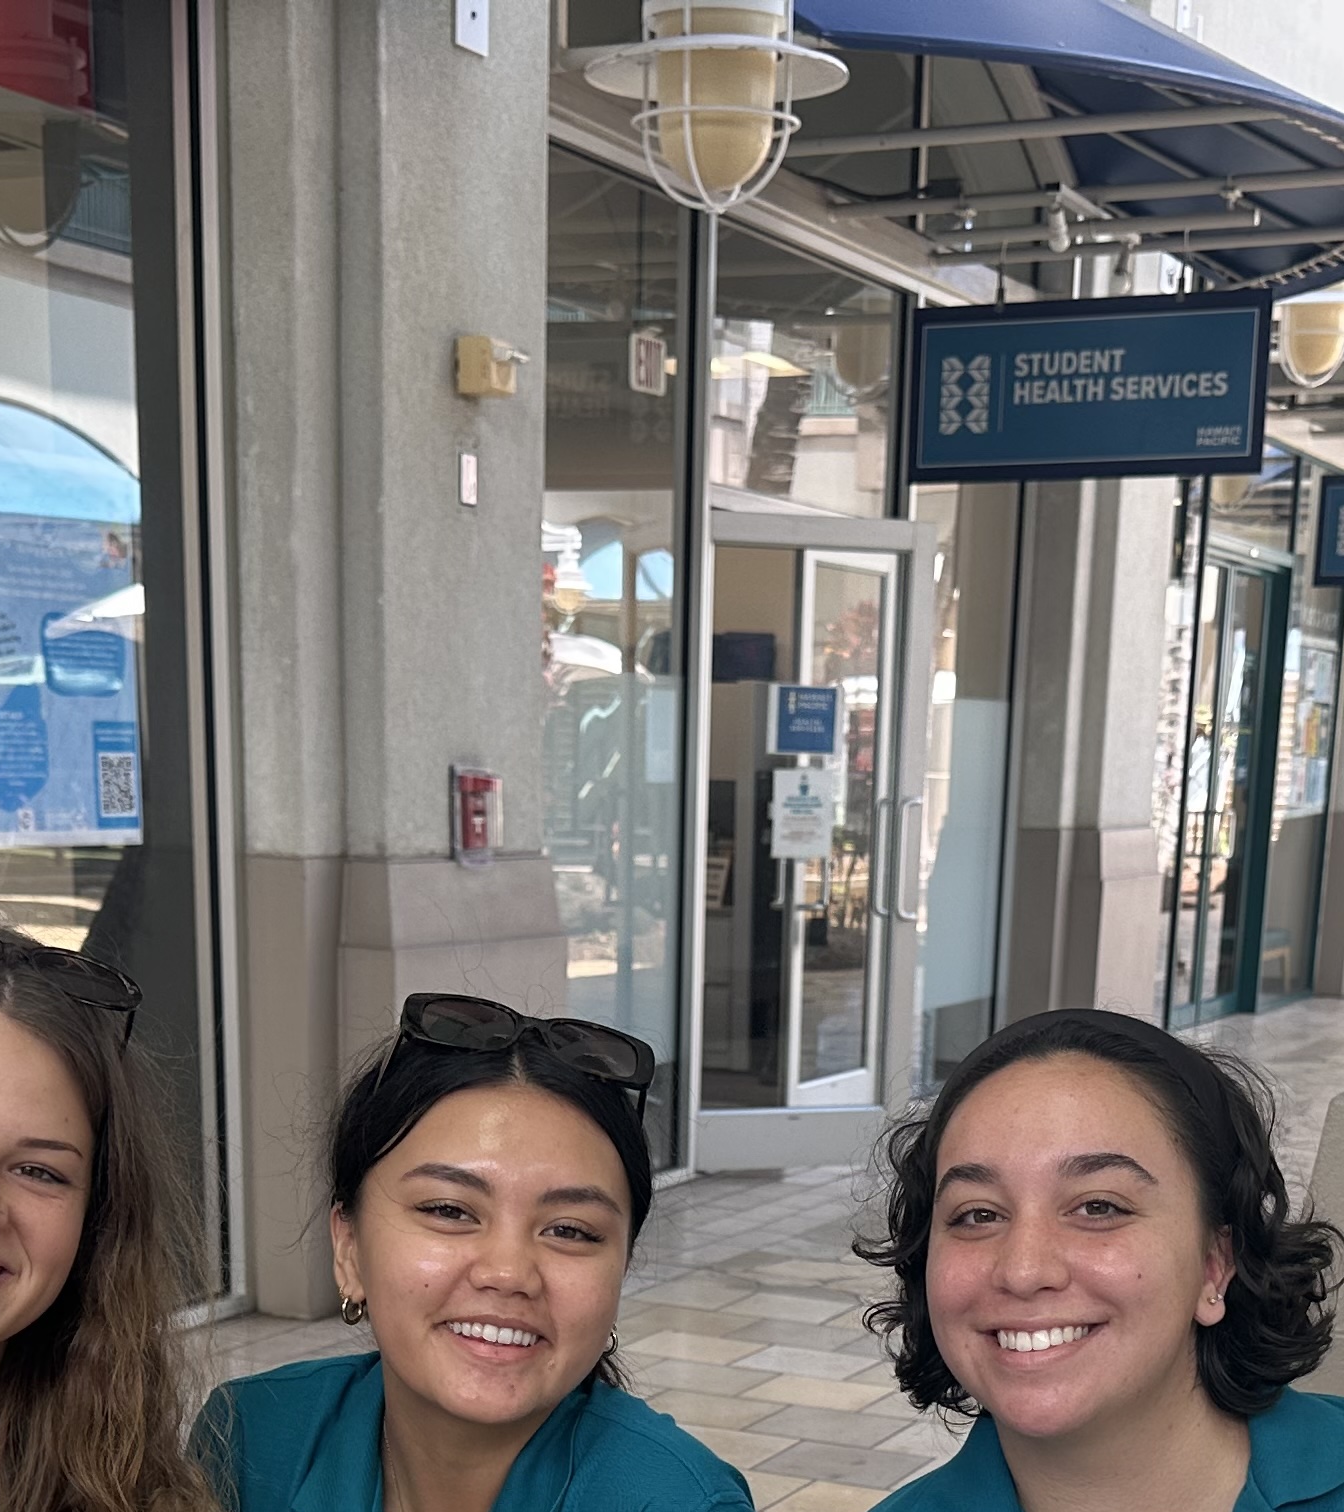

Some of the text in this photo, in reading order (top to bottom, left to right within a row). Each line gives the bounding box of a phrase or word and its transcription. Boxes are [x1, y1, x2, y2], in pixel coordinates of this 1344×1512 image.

[1014, 349, 1126, 377] STUDENT
[1014, 372, 1229, 405] HEALTH SERVICES
